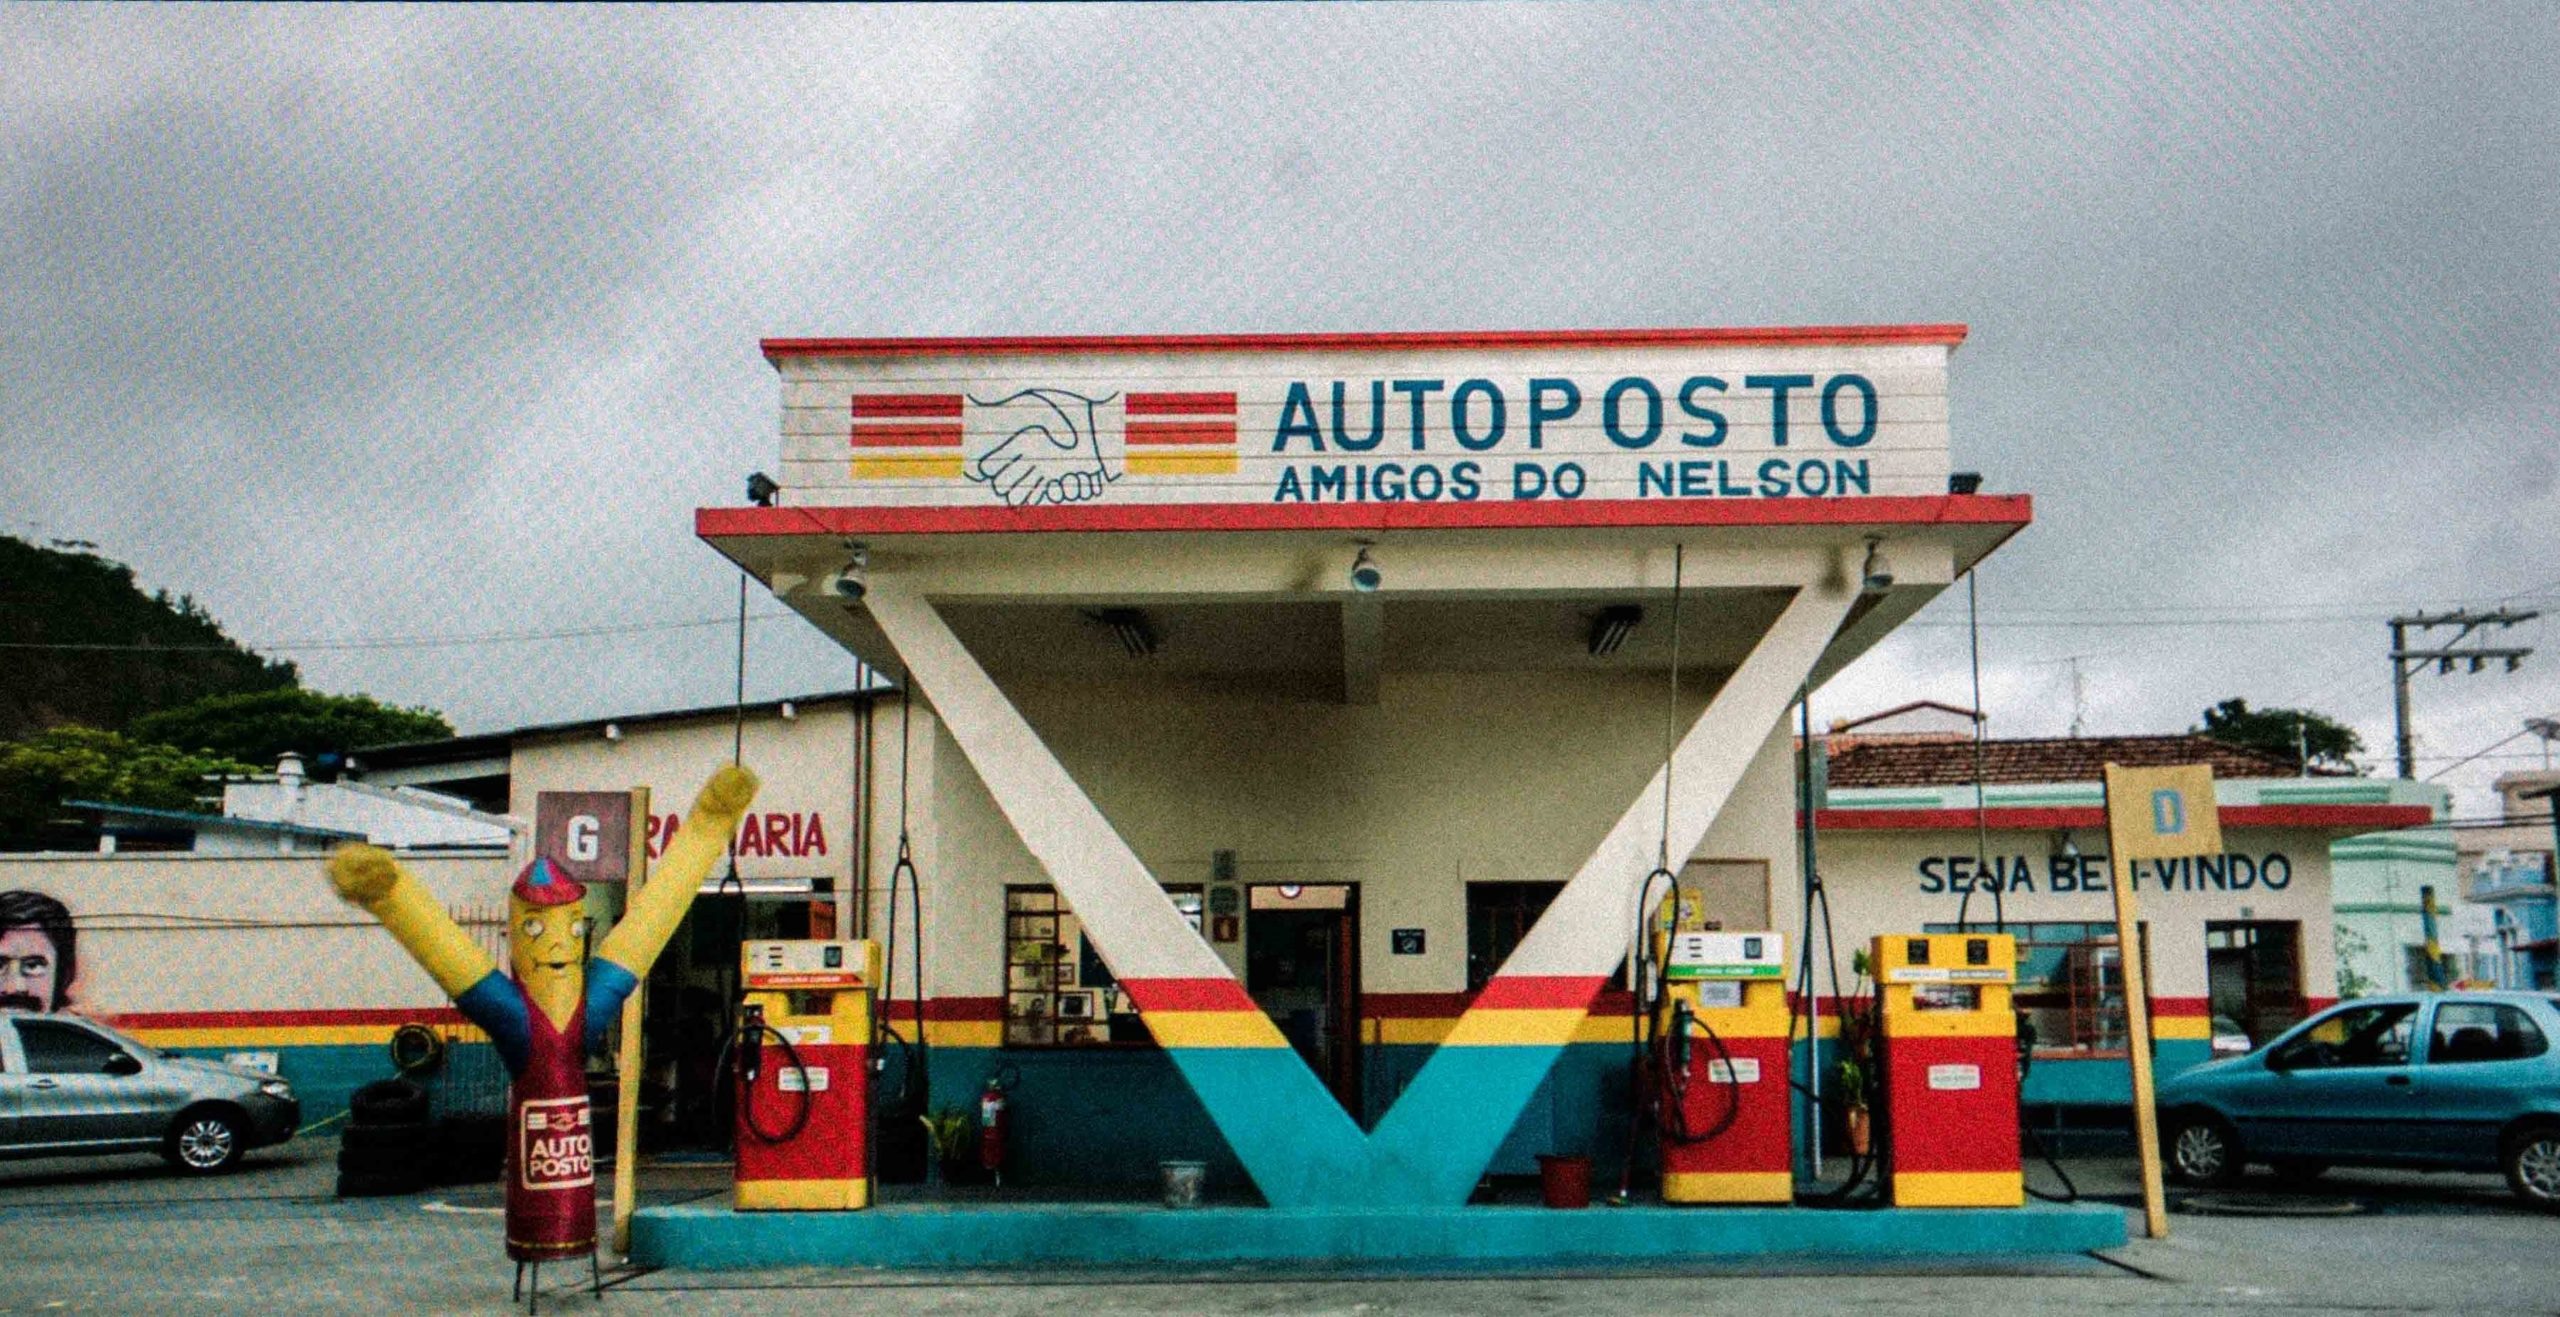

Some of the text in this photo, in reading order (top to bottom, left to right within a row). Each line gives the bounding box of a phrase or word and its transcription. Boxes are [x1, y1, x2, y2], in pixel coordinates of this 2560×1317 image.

[1274, 458, 1871, 503] AMIGOS DO NELSON
[2152, 788, 2186, 835] D
[566, 815, 600, 862] G
[1918, 852, 2293, 895] SEJA BE-VINDO
[529, 1155, 592, 1178] POSTO
[530, 1133, 591, 1159] AUTO
